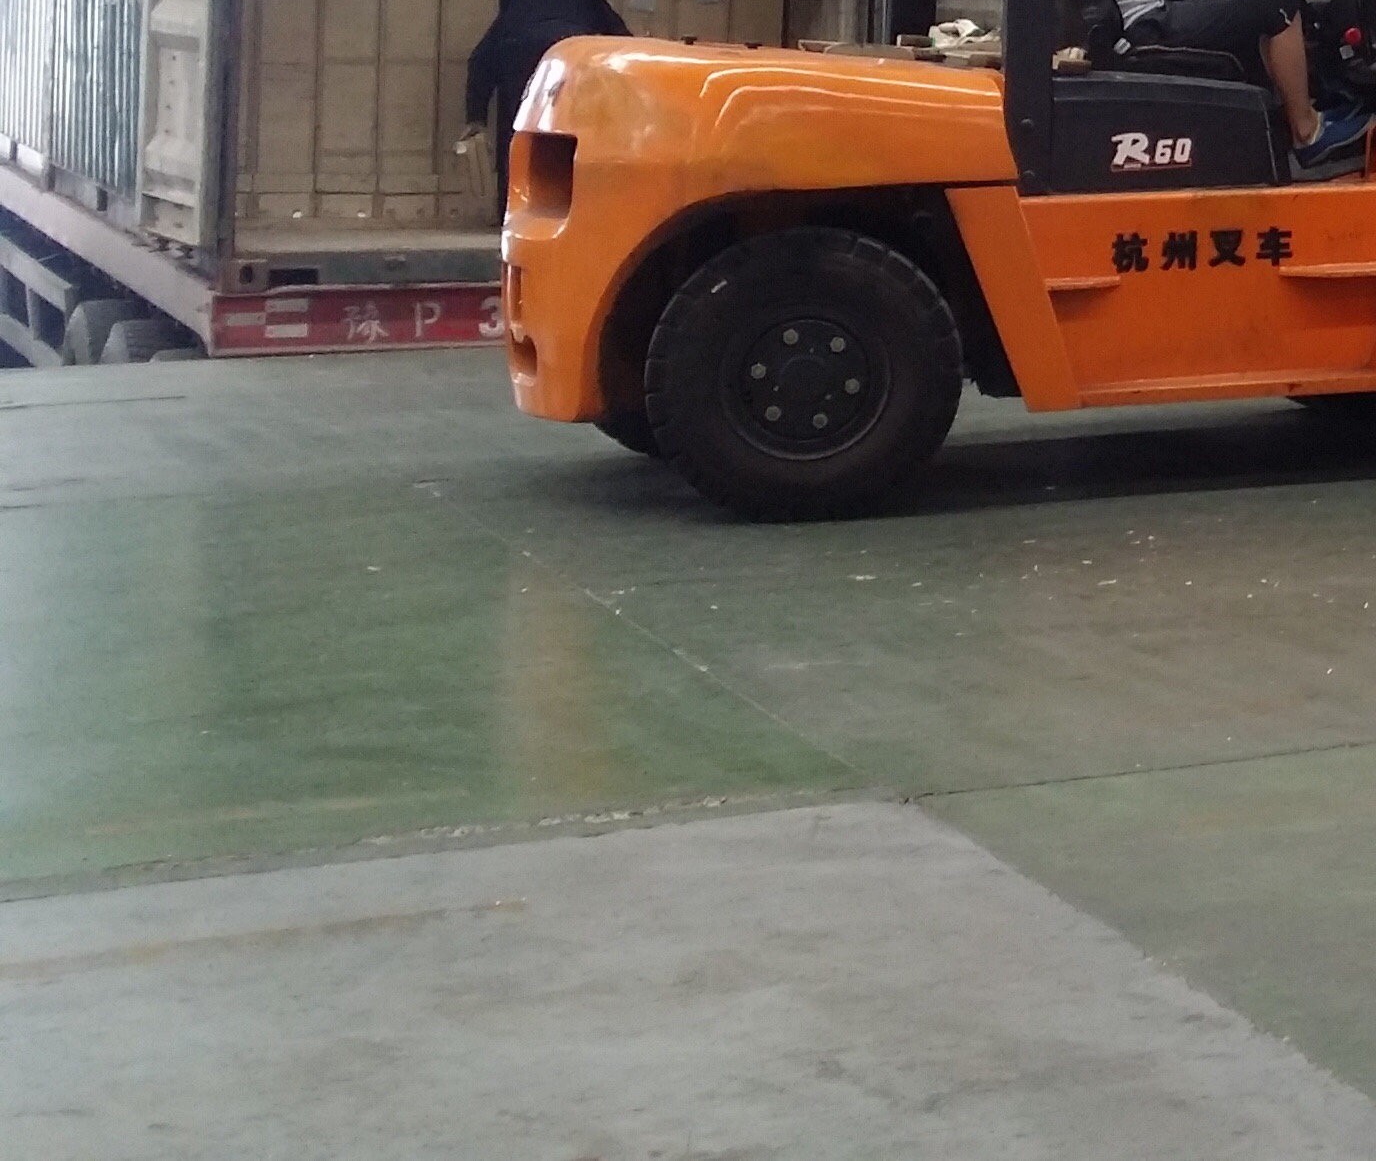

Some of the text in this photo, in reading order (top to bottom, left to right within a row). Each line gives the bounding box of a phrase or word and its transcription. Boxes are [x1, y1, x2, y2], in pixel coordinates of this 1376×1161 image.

[1111, 132, 1192, 166] R60
[1111, 226, 1294, 274] 杭州叉车
